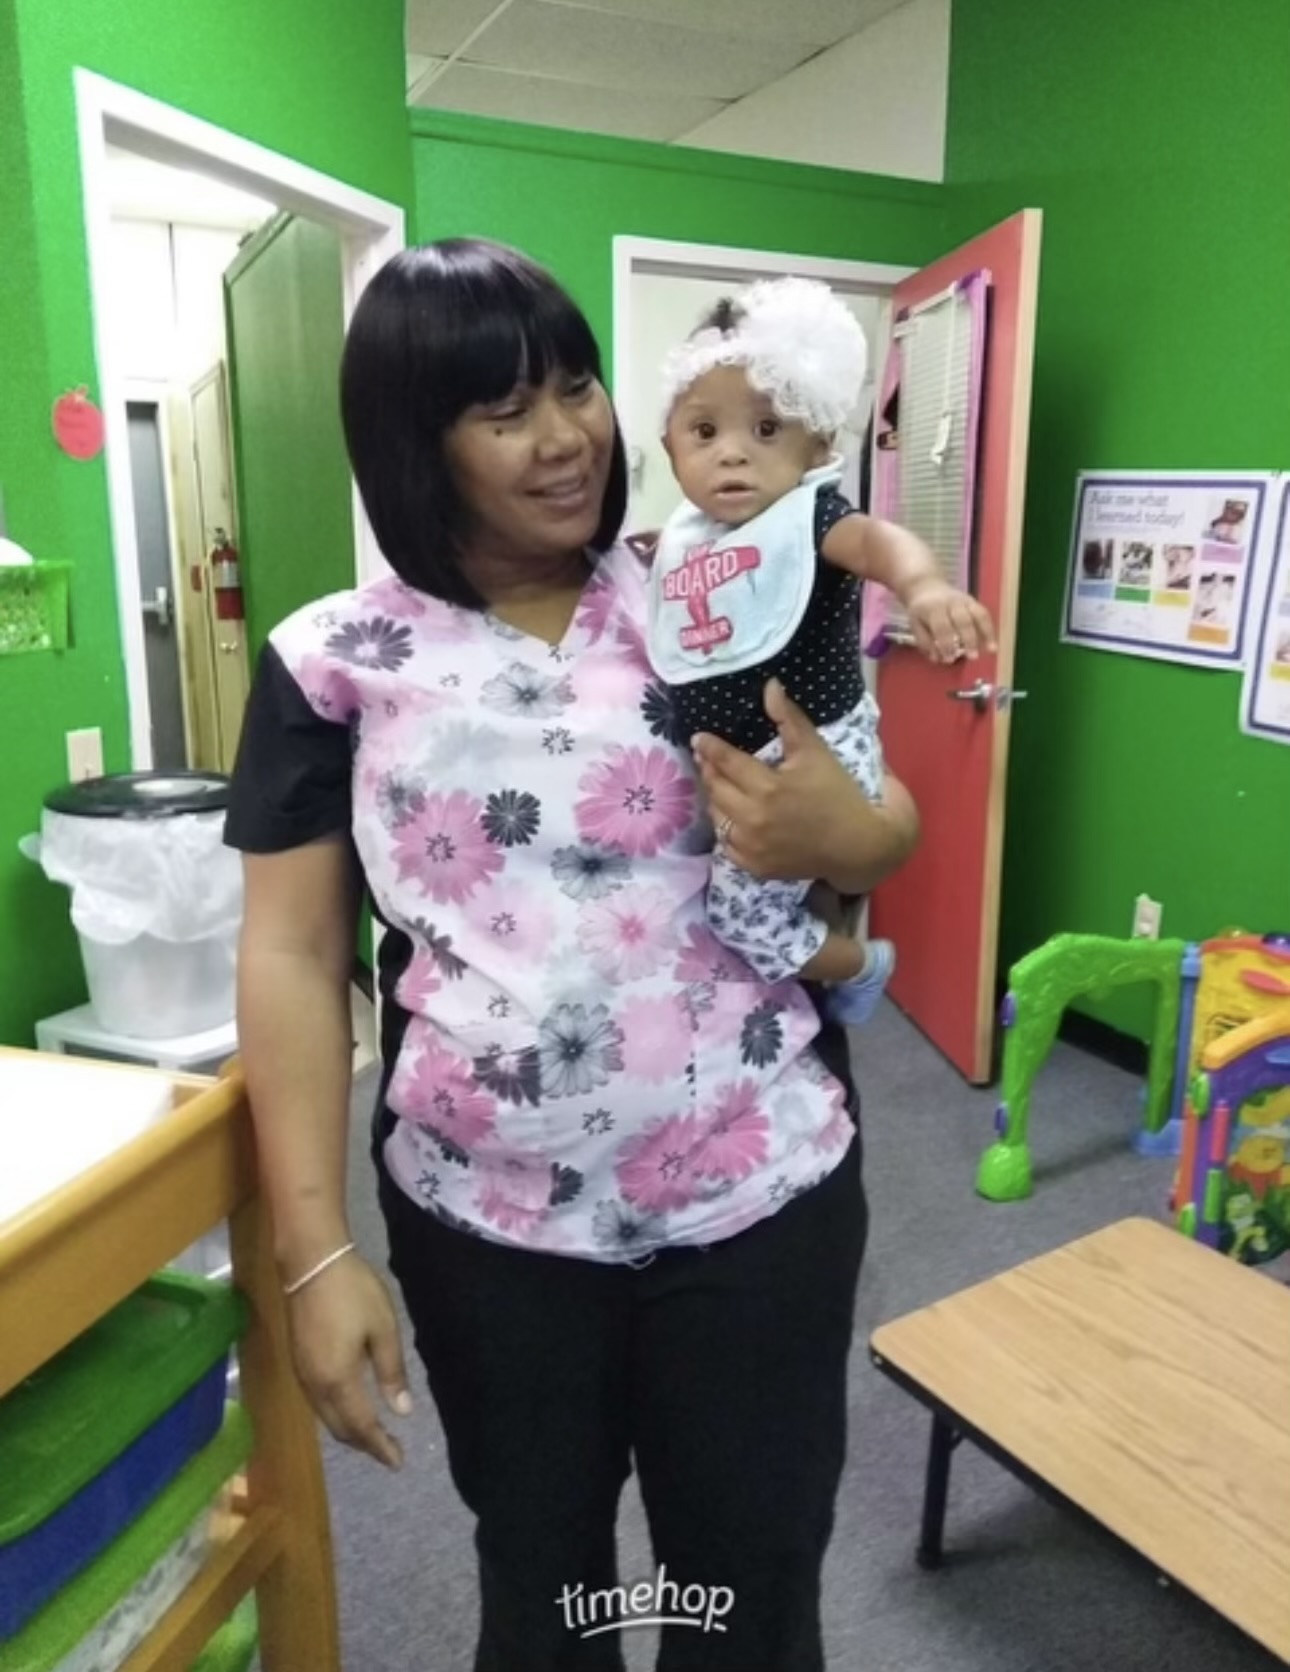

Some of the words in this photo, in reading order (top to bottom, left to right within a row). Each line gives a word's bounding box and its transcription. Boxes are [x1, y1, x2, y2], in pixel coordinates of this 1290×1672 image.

[1087, 490, 1113, 505] Ask
[1115, 494, 1135, 506] me
[1138, 489, 1169, 508] what
[1097, 507, 1142, 524] learned
[664, 550, 738, 599] BOARD
